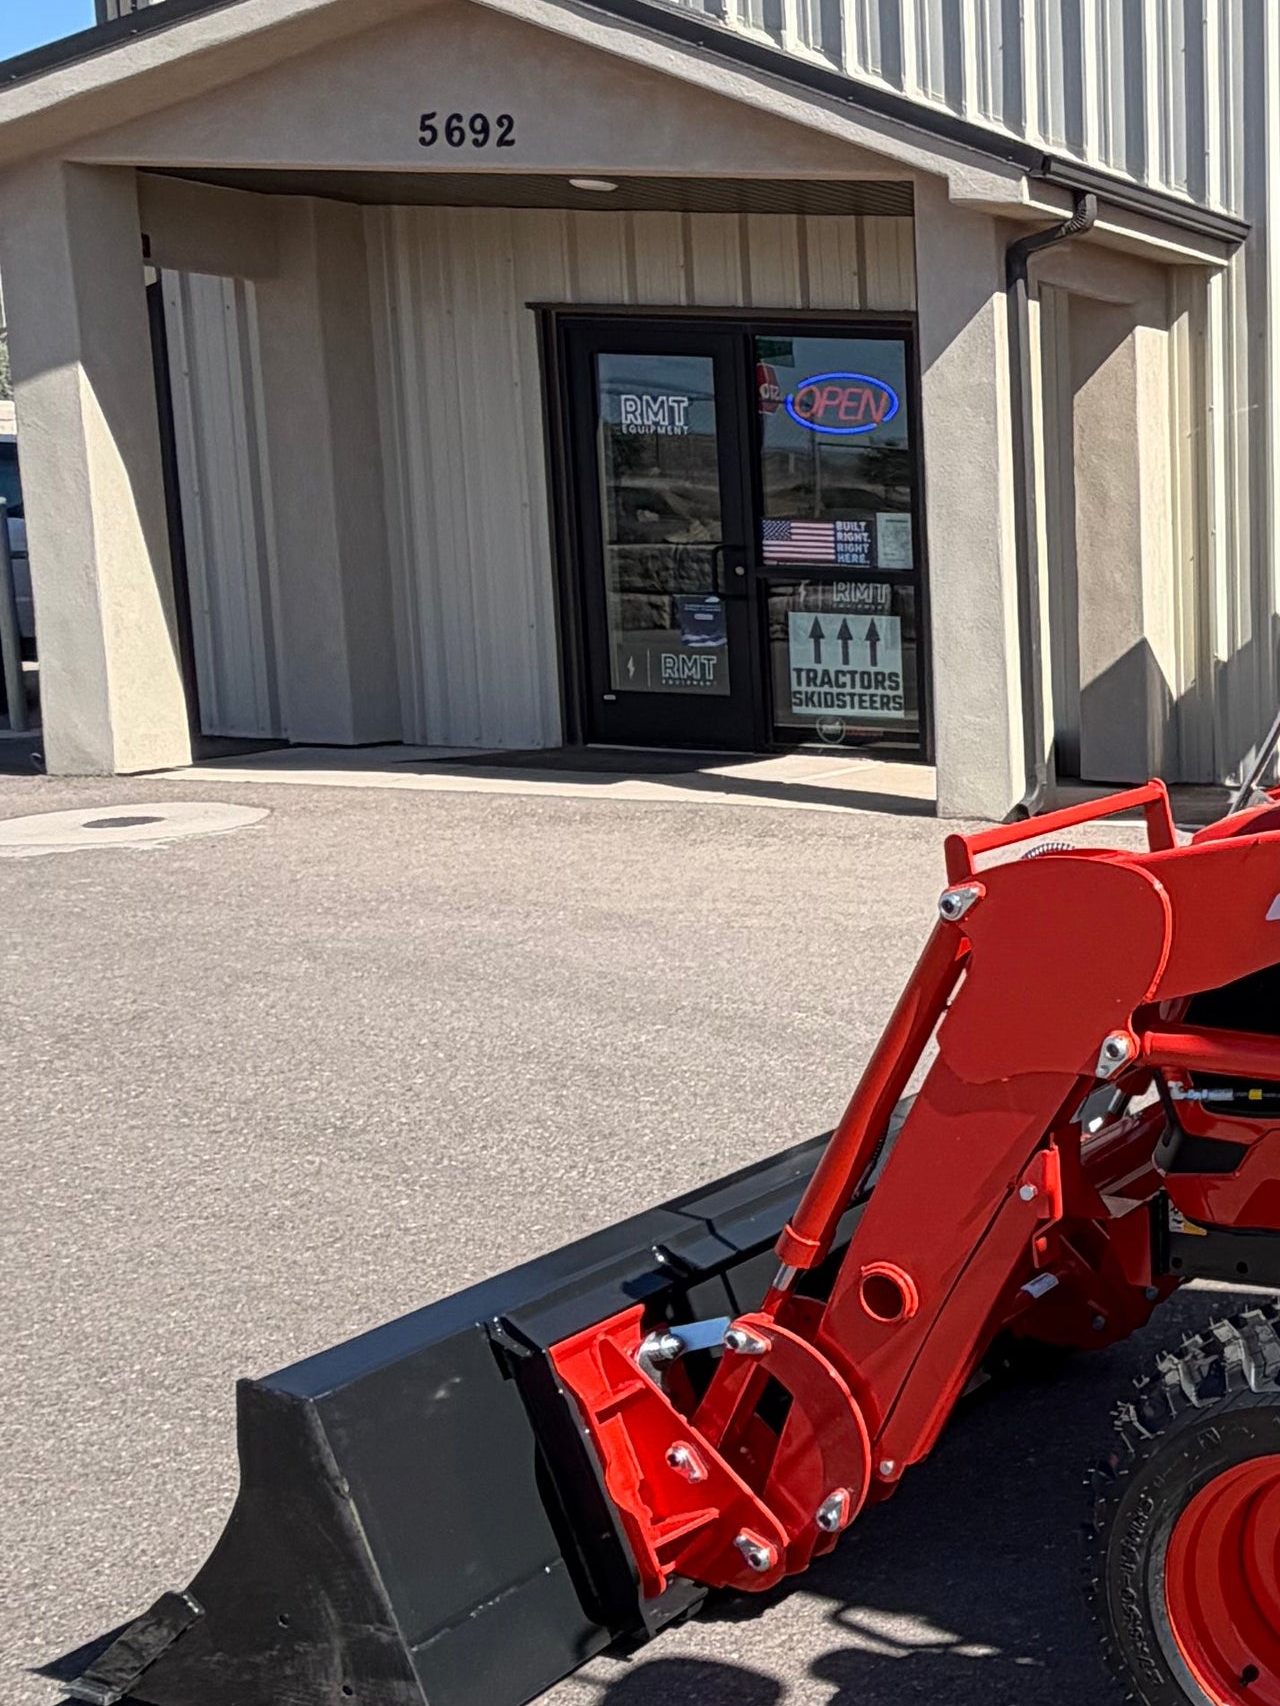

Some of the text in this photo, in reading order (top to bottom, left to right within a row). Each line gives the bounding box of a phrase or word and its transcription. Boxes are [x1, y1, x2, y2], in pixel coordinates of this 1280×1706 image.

[418, 110, 516, 148] 5692
[620, 394, 689, 426] RMT
[794, 384, 888, 424] OPEN
[621, 424, 689, 435] EQUIPMENT
[835, 520, 868, 532] BUILT
[836, 532, 872, 543] RIGHT.
[836, 543, 870, 553] RIGHT
[833, 581, 891, 604] RMT
[661, 653, 717, 680] RMT
[792, 667, 901, 692] TRACTORS
[792, 690, 903, 712] SKIDSTEERS
